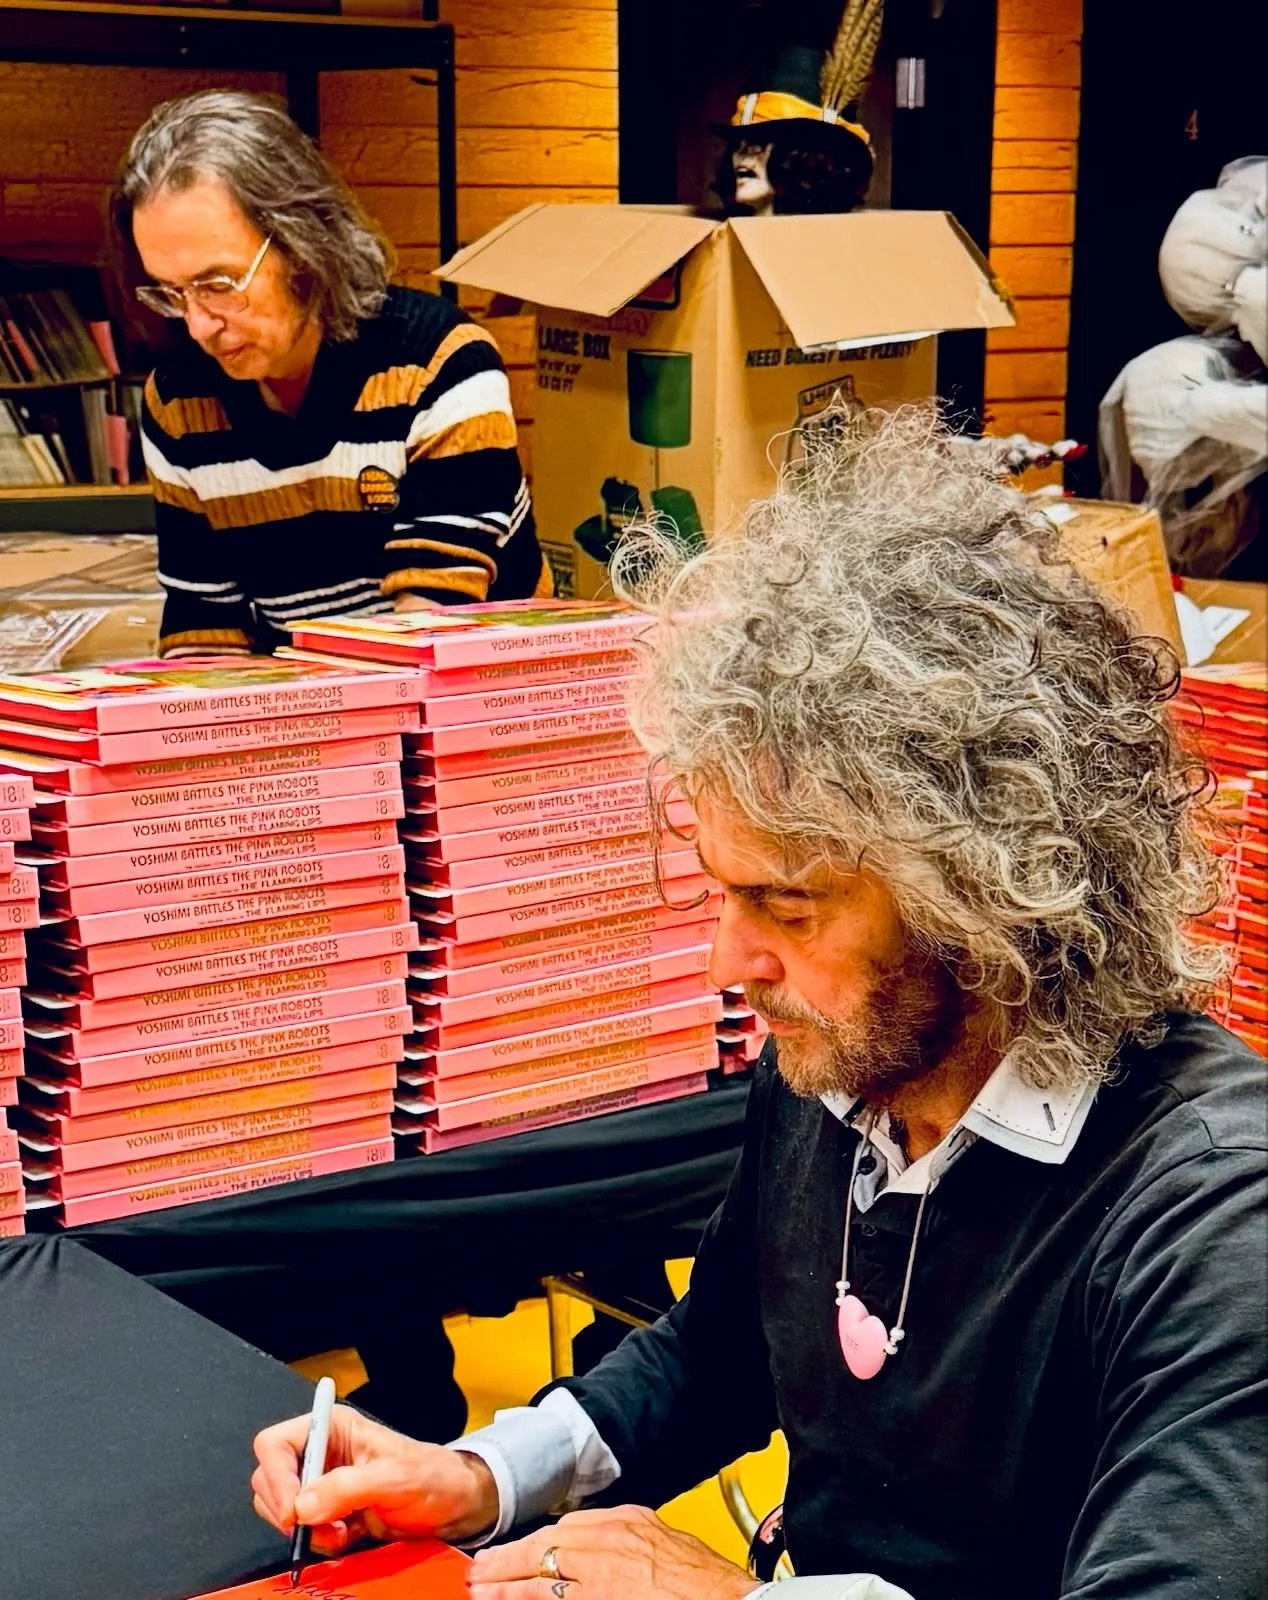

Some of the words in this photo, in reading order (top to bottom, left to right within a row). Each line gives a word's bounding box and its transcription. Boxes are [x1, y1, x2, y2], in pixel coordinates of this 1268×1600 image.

[1184, 109, 1199, 141] 4
[538, 327, 579, 355] LARGE
[583, 333, 610, 360] BOX
[746, 350, 781, 367] NEED
[161, 700, 207, 714] YOSHIMI
[211, 696, 250, 709] BATTLES
[255, 694, 272, 705] THE
[275, 691, 299, 703] PINK
[302, 687, 342, 700] ROBOTS
[262, 706, 278, 714] THE
[283, 702, 321, 712] FLAMING
[325, 700, 343, 709] LIPS
[163, 730, 208, 744] YOSHIMI
[212, 726, 250, 739] BATTLES
[255, 724, 271, 734] THE
[275, 721, 298, 732] PINK
[301, 716, 340, 729] ROBOTS
[263, 734, 278, 743] THE
[283, 730, 321, 741] FLAMING
[325, 728, 342, 737] LIPS
[132, 791, 180, 806] YOSHIMI
[184, 787, 224, 800] BATTLES
[229, 784, 246, 795] THE
[250, 781, 274, 793] PINK
[277, 776, 319, 790] ROBOTS
[237, 795, 252, 804] THE
[258, 790, 297, 802] FLAMING
[302, 788, 319, 798] LIPS
[134, 821, 181, 836] YOSHIMI
[186, 816, 226, 831] BATTLES
[231, 814, 248, 825] THE
[251, 811, 276, 823] PINK
[279, 806, 320, 820] ROBOTS
[238, 825, 254, 834] THE
[260, 820, 299, 831] FLAMING
[304, 817, 321, 826] LIPS
[131, 851, 177, 867] YOSHIMI
[182, 845, 221, 860] BATTLES
[226, 842, 243, 854] THE
[247, 839, 271, 851] PINK
[274, 833, 314, 848] ROBOTS
[234, 853, 250, 862] THE
[255, 847, 294, 860] FLAMING
[298, 845, 316, 854] LIPS
[136, 880, 183, 896] YOSHIMI
[188, 874, 228, 889] BATTLES
[233, 871, 250, 883] THE
[253, 868, 278, 880] PINK
[281, 862, 322, 877] ROBOTS
[241, 882, 257, 891] THE
[262, 876, 302, 888] FLAMING
[306, 874, 324, 883] LIPS
[144, 907, 190, 924] YOSHIMI
[194, 901, 233, 916] BATTLES
[238, 898, 255, 910] THE
[258, 894, 282, 907] PINK
[285, 888, 325, 903] ROBOTS
[247, 908, 262, 918] THE
[267, 902, 305, 915] FLAMING
[309, 900, 326, 909] LIPS
[156, 960, 202, 977] YOSHIMI
[206, 954, 246, 969] BATTLES
[250, 950, 267, 962] THE
[271, 946, 294, 959] PINK
[297, 940, 338, 955] ROBOTS
[259, 961, 274, 970] THE
[279, 955, 317, 968] FLAMING
[321, 952, 338, 962] LIPS
[144, 989, 190, 1006] YOSHIMI
[194, 983, 234, 998] BATTLES
[238, 979, 255, 991] THE
[259, 975, 282, 988] PINK
[285, 969, 326, 984] ROBOTS
[246, 990, 261, 999] THE
[267, 983, 305, 996] FLAMING
[309, 980, 327, 990] LIPS
[137, 1018, 184, 1035] YOSHIMI
[188, 1011, 228, 1027] BATTLES
[233, 1008, 250, 1020] THE
[254, 1004, 278, 1017] PINK
[281, 997, 322, 1013] ROBOTS
[242, 1019, 257, 1029] THE
[262, 1012, 302, 1026] FLAMING
[306, 1009, 323, 1019] LIPS
[145, 1047, 192, 1065] YOSHIMI
[196, 1040, 236, 1056] BATTLES
[241, 1036, 258, 1049] THE
[262, 1032, 286, 1046] PINK
[289, 1024, 330, 1041] ROBOTS
[249, 1047, 265, 1056] THE
[270, 1040, 309, 1053] FLAMING
[313, 1037, 331, 1047] LIPS
